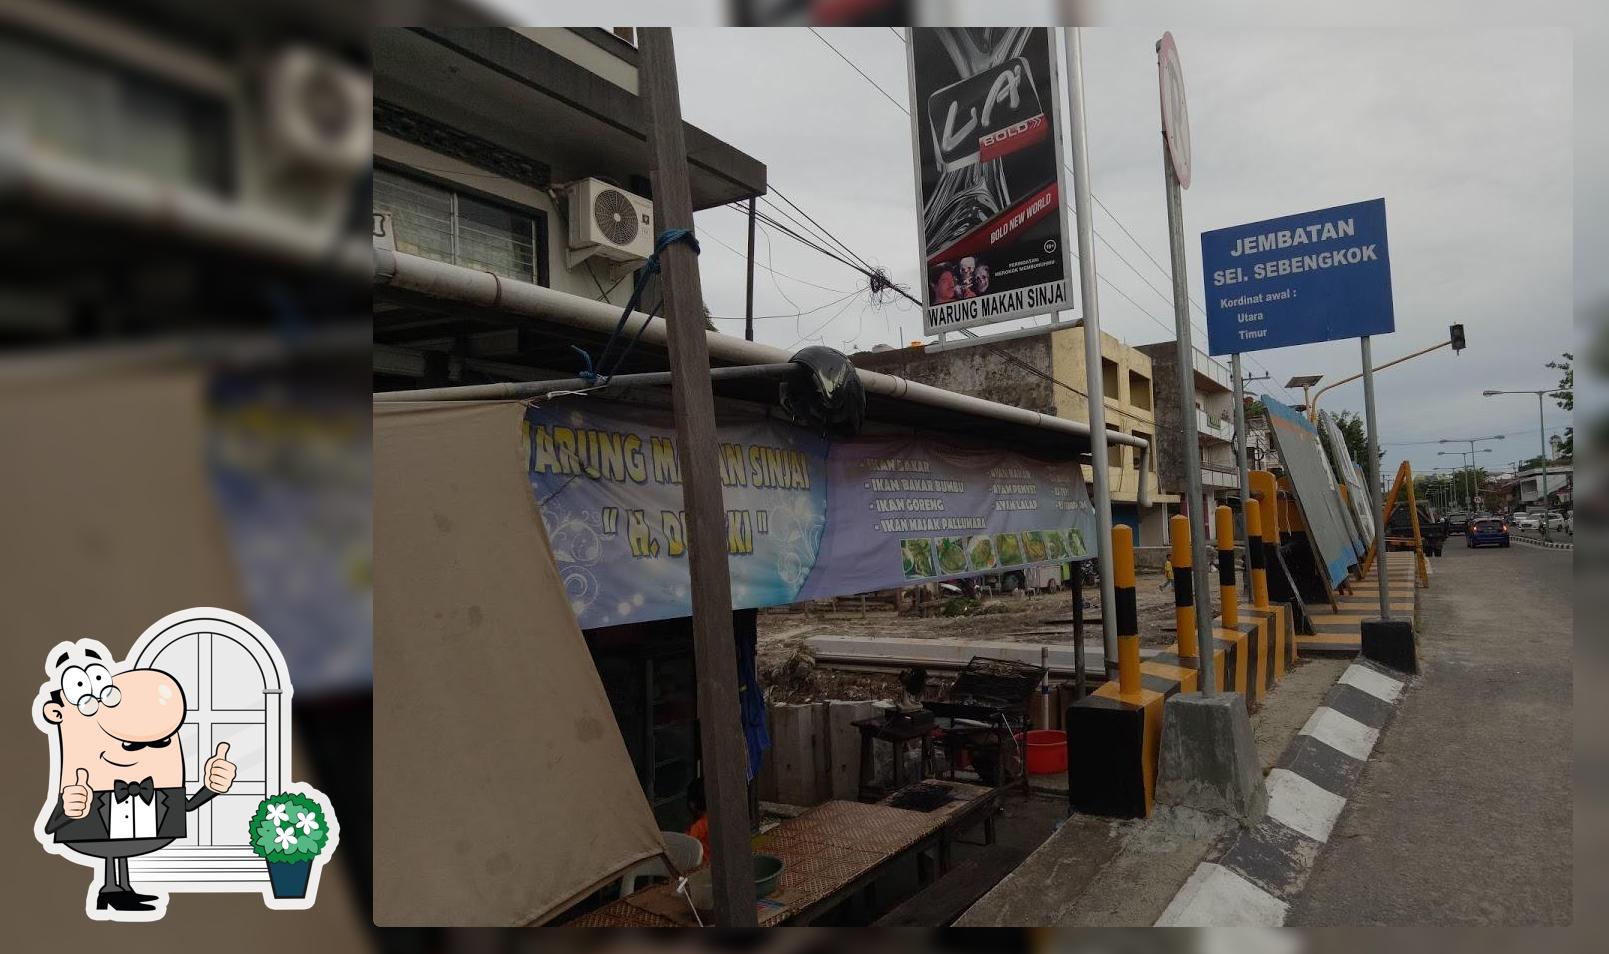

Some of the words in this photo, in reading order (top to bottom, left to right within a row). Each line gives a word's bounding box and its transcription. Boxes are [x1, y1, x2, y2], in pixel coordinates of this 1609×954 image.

[983, 122, 1029, 147] BOLD
[990, 223, 1009, 244] BOLD
[1009, 212, 1025, 230] NEW
[1026, 193, 1051, 218] WORLD
[1231, 218, 1355, 257] JEMBATAN
[1213, 267, 1248, 286] SEI.
[1254, 243, 1378, 280] SEBENGKOK
[928, 300, 978, 328] WARUNG
[982, 292, 1023, 317] MAKAN
[1027, 281, 1067, 309] SINJAI
[1220, 291, 1263, 309] Kordinat
[1265, 288, 1290, 302] awal
[1237, 311, 1263, 323] Utara
[1238, 328, 1268, 340] Timur
[750, 444, 811, 490] SINJAI
[871, 478, 900, 492] IKAN
[901, 478, 934, 492] BAKAR
[876, 498, 905, 512] IKAN
[906, 498, 944, 512] GORENG
[880, 518, 908, 532] IKAN
